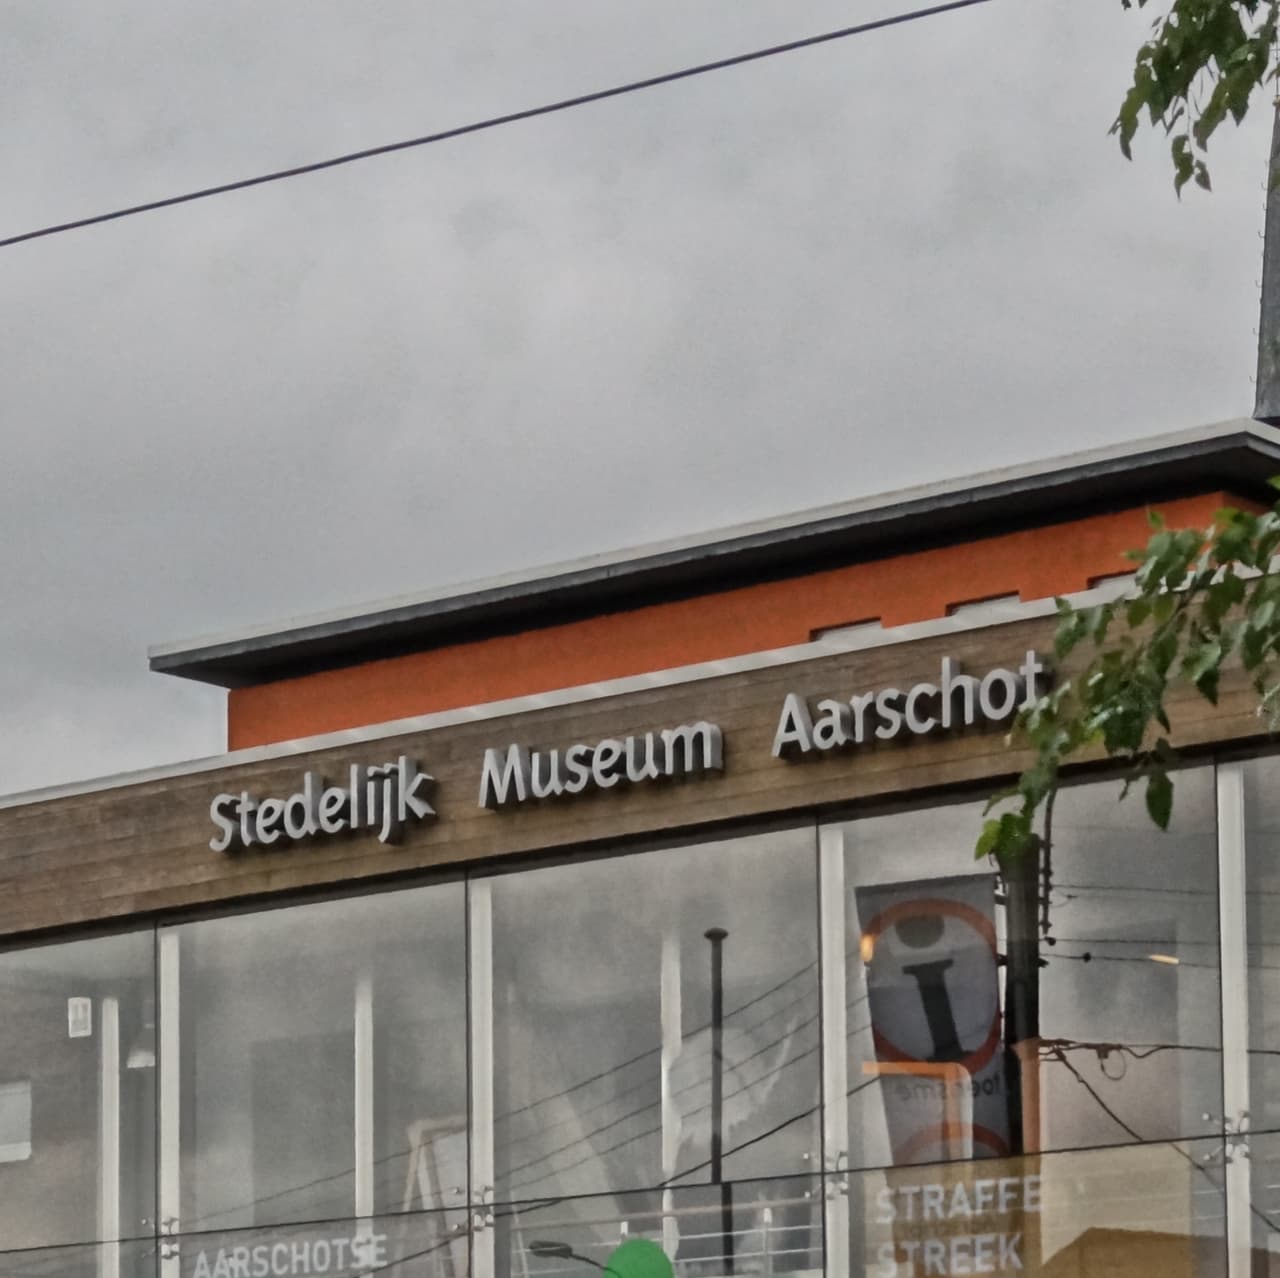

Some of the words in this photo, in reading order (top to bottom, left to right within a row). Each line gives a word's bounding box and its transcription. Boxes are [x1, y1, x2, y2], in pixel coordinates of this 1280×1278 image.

[208, 755, 436, 852] Stedelijk
[478, 720, 723, 808] Museum
[771, 650, 1044, 758] Aarschot
[875, 1175, 1044, 1224] STRAFFE
